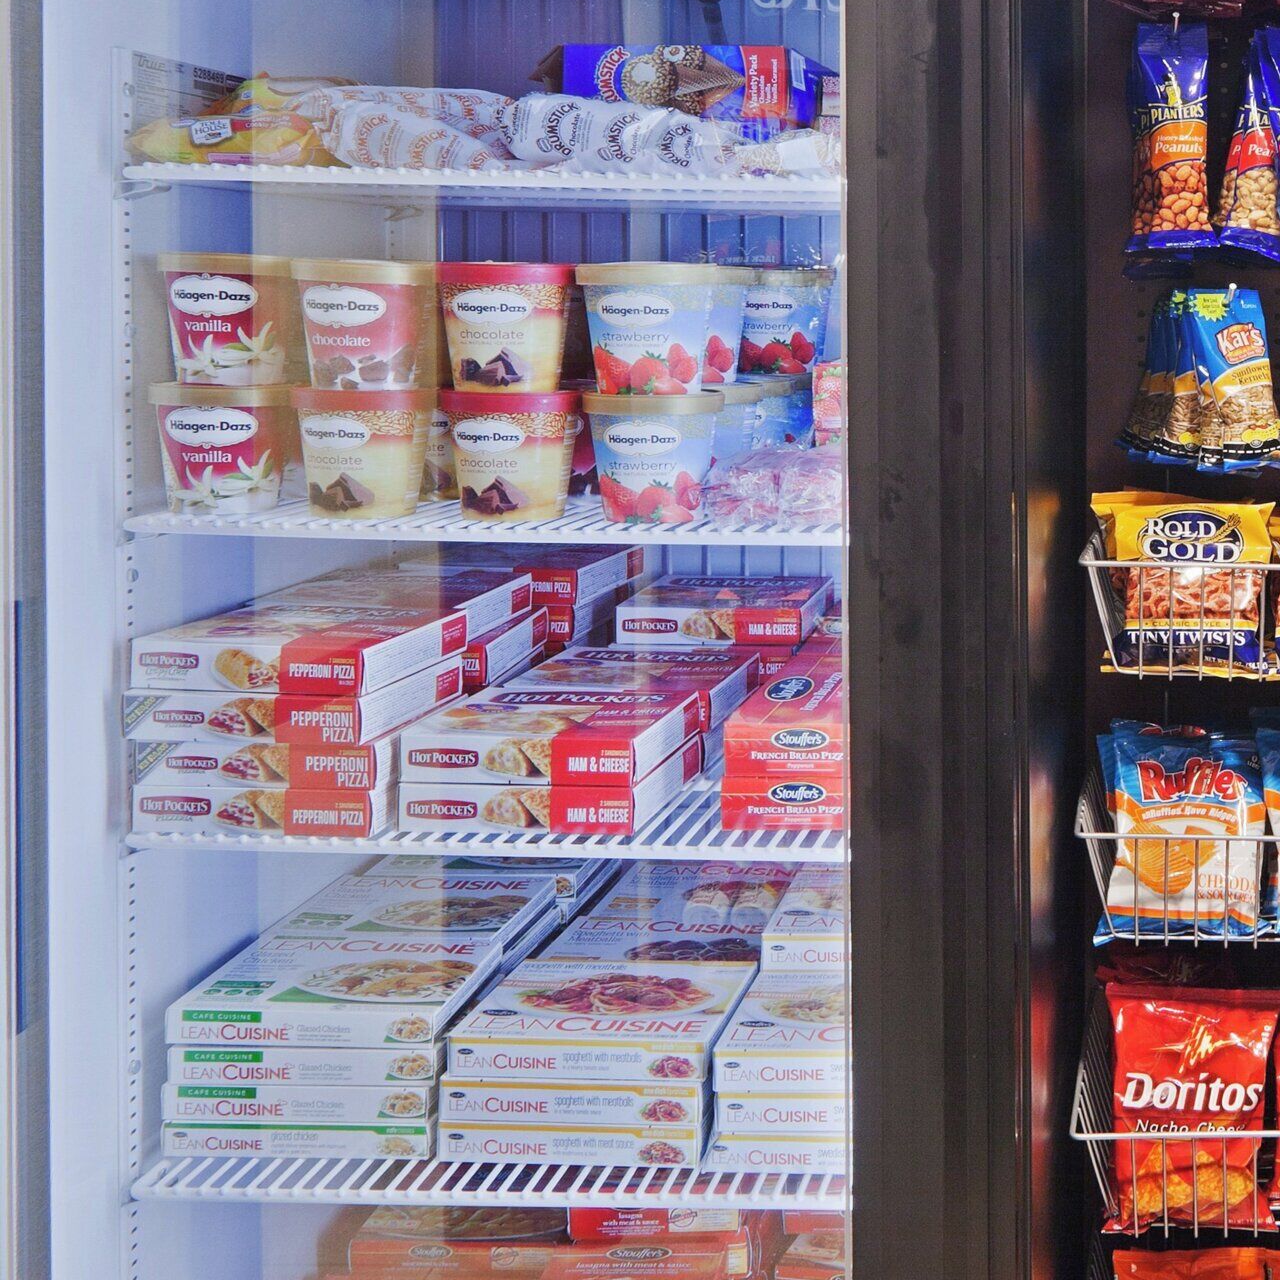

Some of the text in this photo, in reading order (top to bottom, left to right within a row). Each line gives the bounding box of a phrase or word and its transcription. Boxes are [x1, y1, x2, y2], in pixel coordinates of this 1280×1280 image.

[749, 54, 759, 108] Variety Pack
[1151, 103, 1204, 120] PLANTERS
[1155, 141, 1203, 154] Peanuts
[184, 320, 231, 333] vanilla
[312, 334, 371, 348] chocolate
[460, 329, 525, 340] chocolate
[602, 331, 670, 344] strawberry
[1217, 322, 1266, 355] Kar's
[182, 450, 232, 463] vanilla
[608, 460, 677, 472] strawberry
[1145, 518, 1217, 540] ROLD
[1143, 537, 1240, 563] GOLD
[624, 620, 676, 631] HOT POCKETS
[748, 623, 797, 636] HAM & CHEESE
[1128, 631, 1246, 646] TINY TWISTS
[289, 664, 355, 679] PEPPERONI PIZZA
[291, 711, 353, 727] PEPPERONI
[322, 728, 354, 743] PIZZA
[780, 730, 823, 747] Stouffer's
[411, 752, 476, 764] HOT POCKETS
[751, 751, 844, 761] FRENCH BREAD PIZZ
[305, 756, 369, 772] PEPPERONI
[568, 757, 630, 773] HAM & CHEESE
[337, 773, 369, 788] PIZZA
[1137, 756, 1248, 803] Ruffles
[142, 800, 208, 813] HOT POCKETS
[192, 1012, 252, 1021] CAFE CUISINE
[562, 1051, 642, 1064] spaghetti with meatballs
[1122, 1071, 1263, 1112] Doritos
[1136, 1118, 1189, 1133] Nacho
